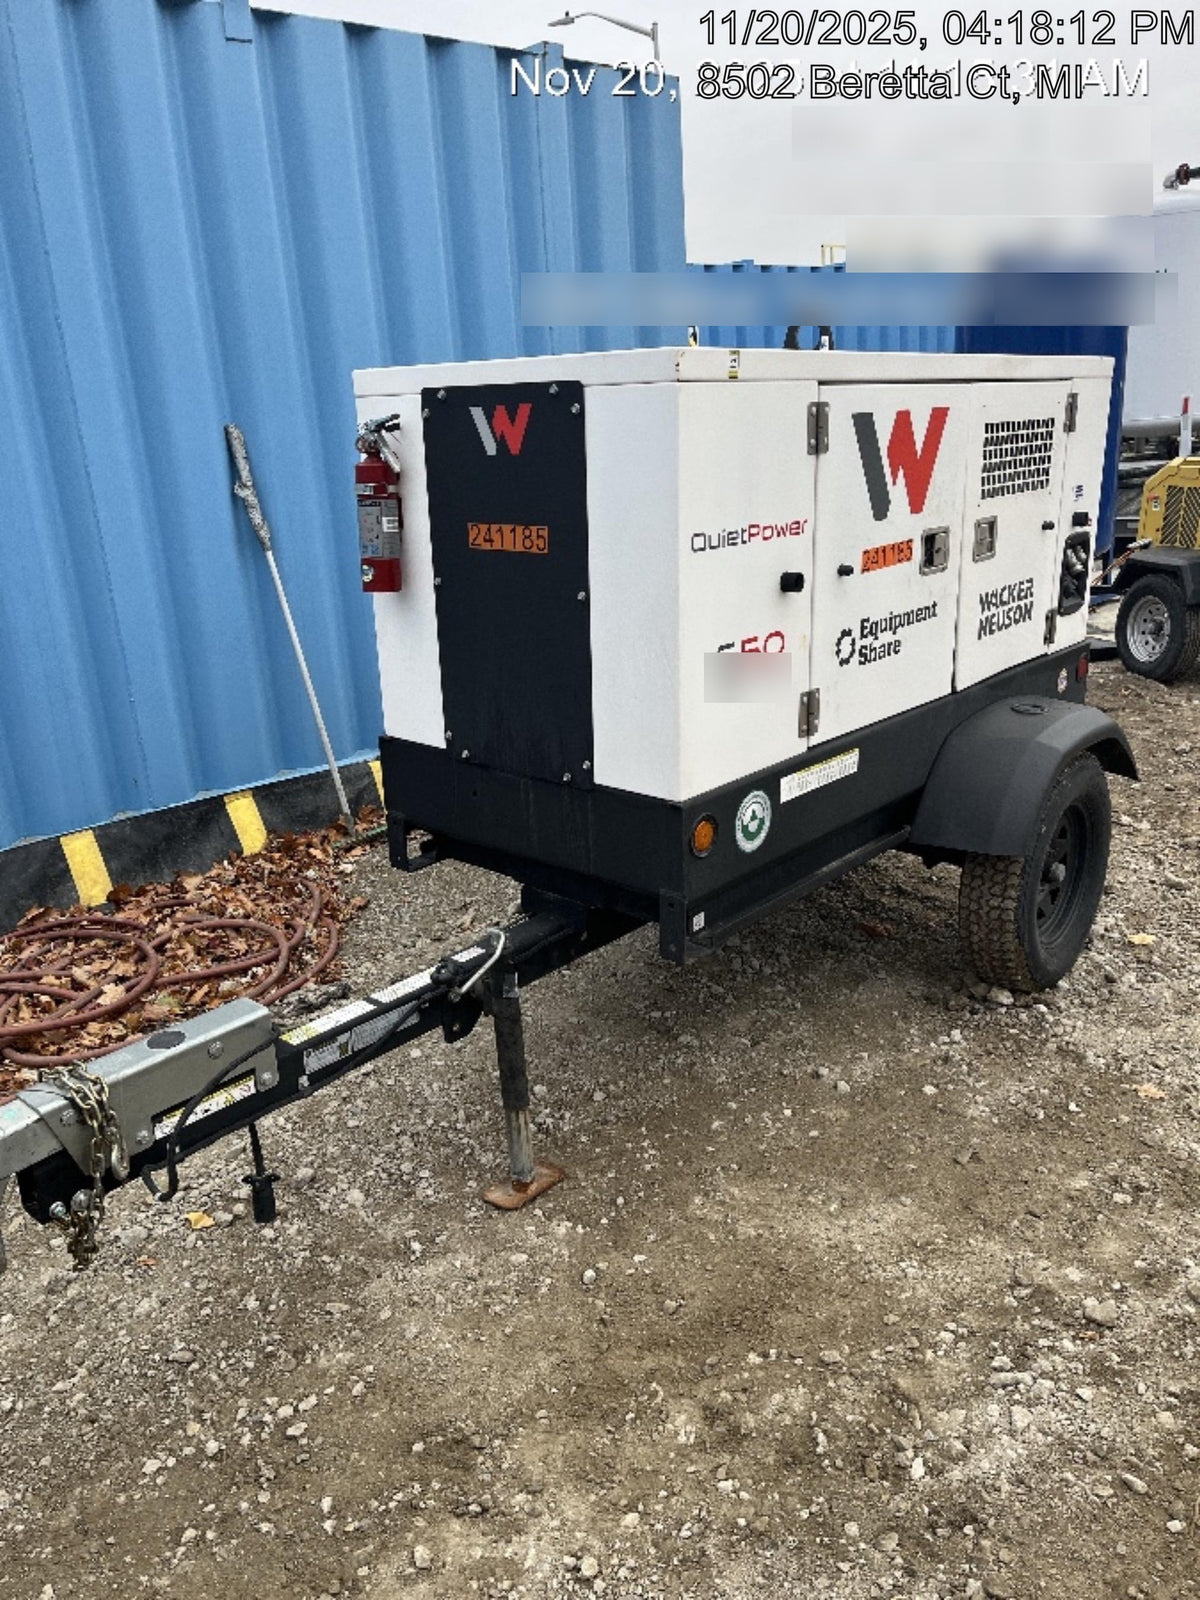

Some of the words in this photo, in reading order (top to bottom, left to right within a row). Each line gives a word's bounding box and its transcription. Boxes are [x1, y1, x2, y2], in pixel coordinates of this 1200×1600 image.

[470, 523, 547, 552] 241185
[690, 519, 808, 553] QuietPower
[978, 577, 1035, 615] WACKER
[859, 600, 938, 641] Equipment
[976, 600, 1035, 641] NEUSON
[858, 638, 902, 666] Share
